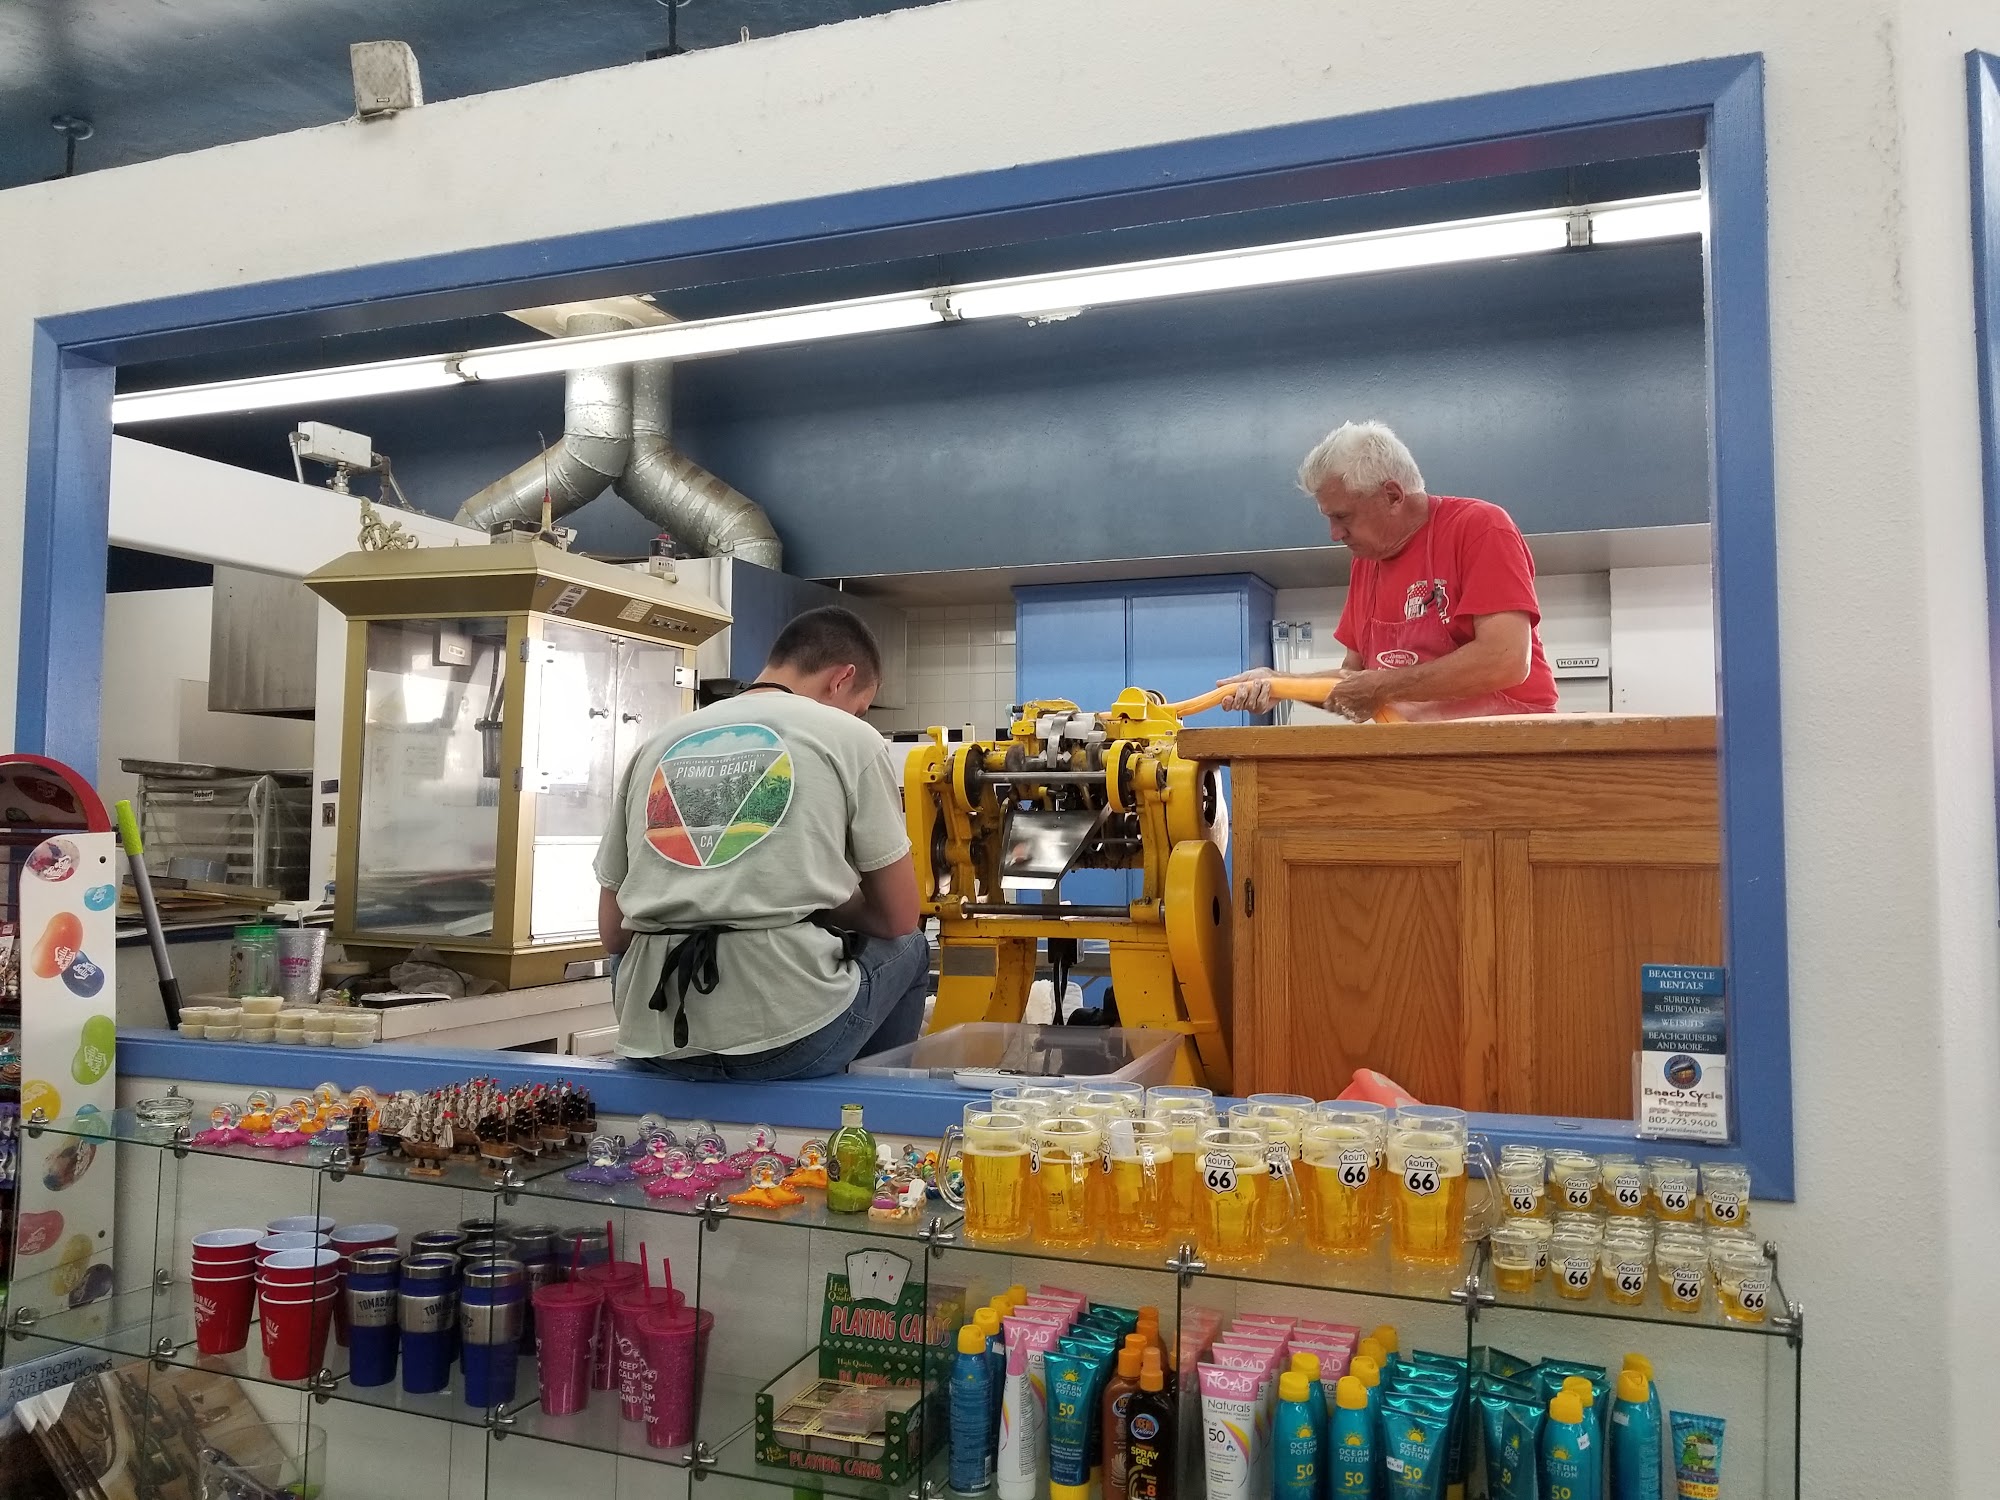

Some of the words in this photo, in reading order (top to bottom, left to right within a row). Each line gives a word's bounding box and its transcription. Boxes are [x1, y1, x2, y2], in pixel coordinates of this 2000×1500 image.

[1560, 659, 1595, 667] HOBART
[676, 765, 715, 779] PISMO
[720, 759, 757, 776] BEACH
[700, 835, 713, 848] CA
[1648, 969, 1682, 979] BEACH
[1683, 970, 1716, 980] CYCLE
[1659, 980, 1704, 990] RENTALS
[1663, 995, 1701, 1004] SURREYS
[1654, 1004, 1711, 1014] SURFBOARDS
[1661, 1018, 1705, 1028] WETSUITS
[1648, 1031, 1718, 1042] BEACHCRUISERS
[1656, 1041, 1677, 1050] AND
[1644, 1087, 1686, 1098] Beach
[1688, 1090, 1724, 1103] Cycle
[1658, 1097, 1709, 1108] Rentals
[1648, 1115, 1718, 1128] 805.773.9400
[1207, 1156, 1232, 1167] ROUTE
[1343, 1153, 1366, 1162] ROUTE
[1408, 1159, 1434, 1169] ROUTE
[1208, 1169, 1231, 1189] 66
[1344, 1165, 1366, 1184] 66
[1409, 1172, 1435, 1191] 66
[1567, 1180, 1589, 1188] ROUTE
[1617, 1179, 1638, 1187] ROUTE
[1569, 1190, 1588, 1204] 66
[1619, 1188, 1638, 1203] 66
[1666, 1193, 1686, 1208] 66
[1713, 1194, 1736, 1202] ROUTE
[1513, 1196, 1532, 1210] 66
[1715, 1203, 1735, 1219] 66
[1567, 1260, 1590, 1268] ROUTE
[1620, 1265, 1643, 1273] ROUTE
[1568, 1271, 1588, 1285] 66
[1676, 1271, 1700, 1280] ROUTE
[829, 1282, 849, 1293] High
[1621, 1275, 1642, 1291] 66
[1742, 1282, 1767, 1290] ROUTE
[1677, 1282, 1698, 1298] 66
[828, 1291, 855, 1303] Quality
[1744, 1292, 1764, 1308] 66
[829, 1304, 897, 1342] PLAYING
[899, 1313, 952, 1349] CARDS
[618, 1360, 638, 1371] KEEP
[8, 1371, 37, 1390] 2018
[40, 1355, 86, 1380] TROPHY
[618, 1368, 641, 1380] CALM
[6, 1375, 59, 1403] ANTLERS
[61, 1373, 70, 1384] &
[74, 1358, 113, 1380] HORNS
[1206, 1375, 1253, 1393] NO-AD
[621, 1384, 636, 1394] EAT
[1055, 1382, 1082, 1392] OCEAN
[1055, 1388, 1082, 1398] POTION
[1059, 1402, 1075, 1416] 50
[1207, 1399, 1251, 1413] Naturals
[1208, 1428, 1226, 1443] 50
[1290, 1440, 1317, 1450] OCEAN
[1399, 1442, 1431, 1454] OCEAN
[1130, 1446, 1159, 1461] SPRAY
[1290, 1447, 1317, 1456] POTION
[1339, 1448, 1369, 1457] OCEAN
[1399, 1449, 1430, 1461] POTION
[788, 1450, 842, 1475] PLAYING
[843, 1460, 884, 1481] CARDS
[1136, 1457, 1153, 1467] GEL
[1339, 1455, 1369, 1464] POTION
[1546, 1459, 1578, 1472] OCEAN
[1296, 1463, 1314, 1480] 50
[1403, 1464, 1422, 1480] 50
[1546, 1466, 1578, 1478] POTION
[1345, 1471, 1364, 1487] 50
[1147, 1484, 1156, 1497] 8
[1551, 1484, 1571, 1500] 50
